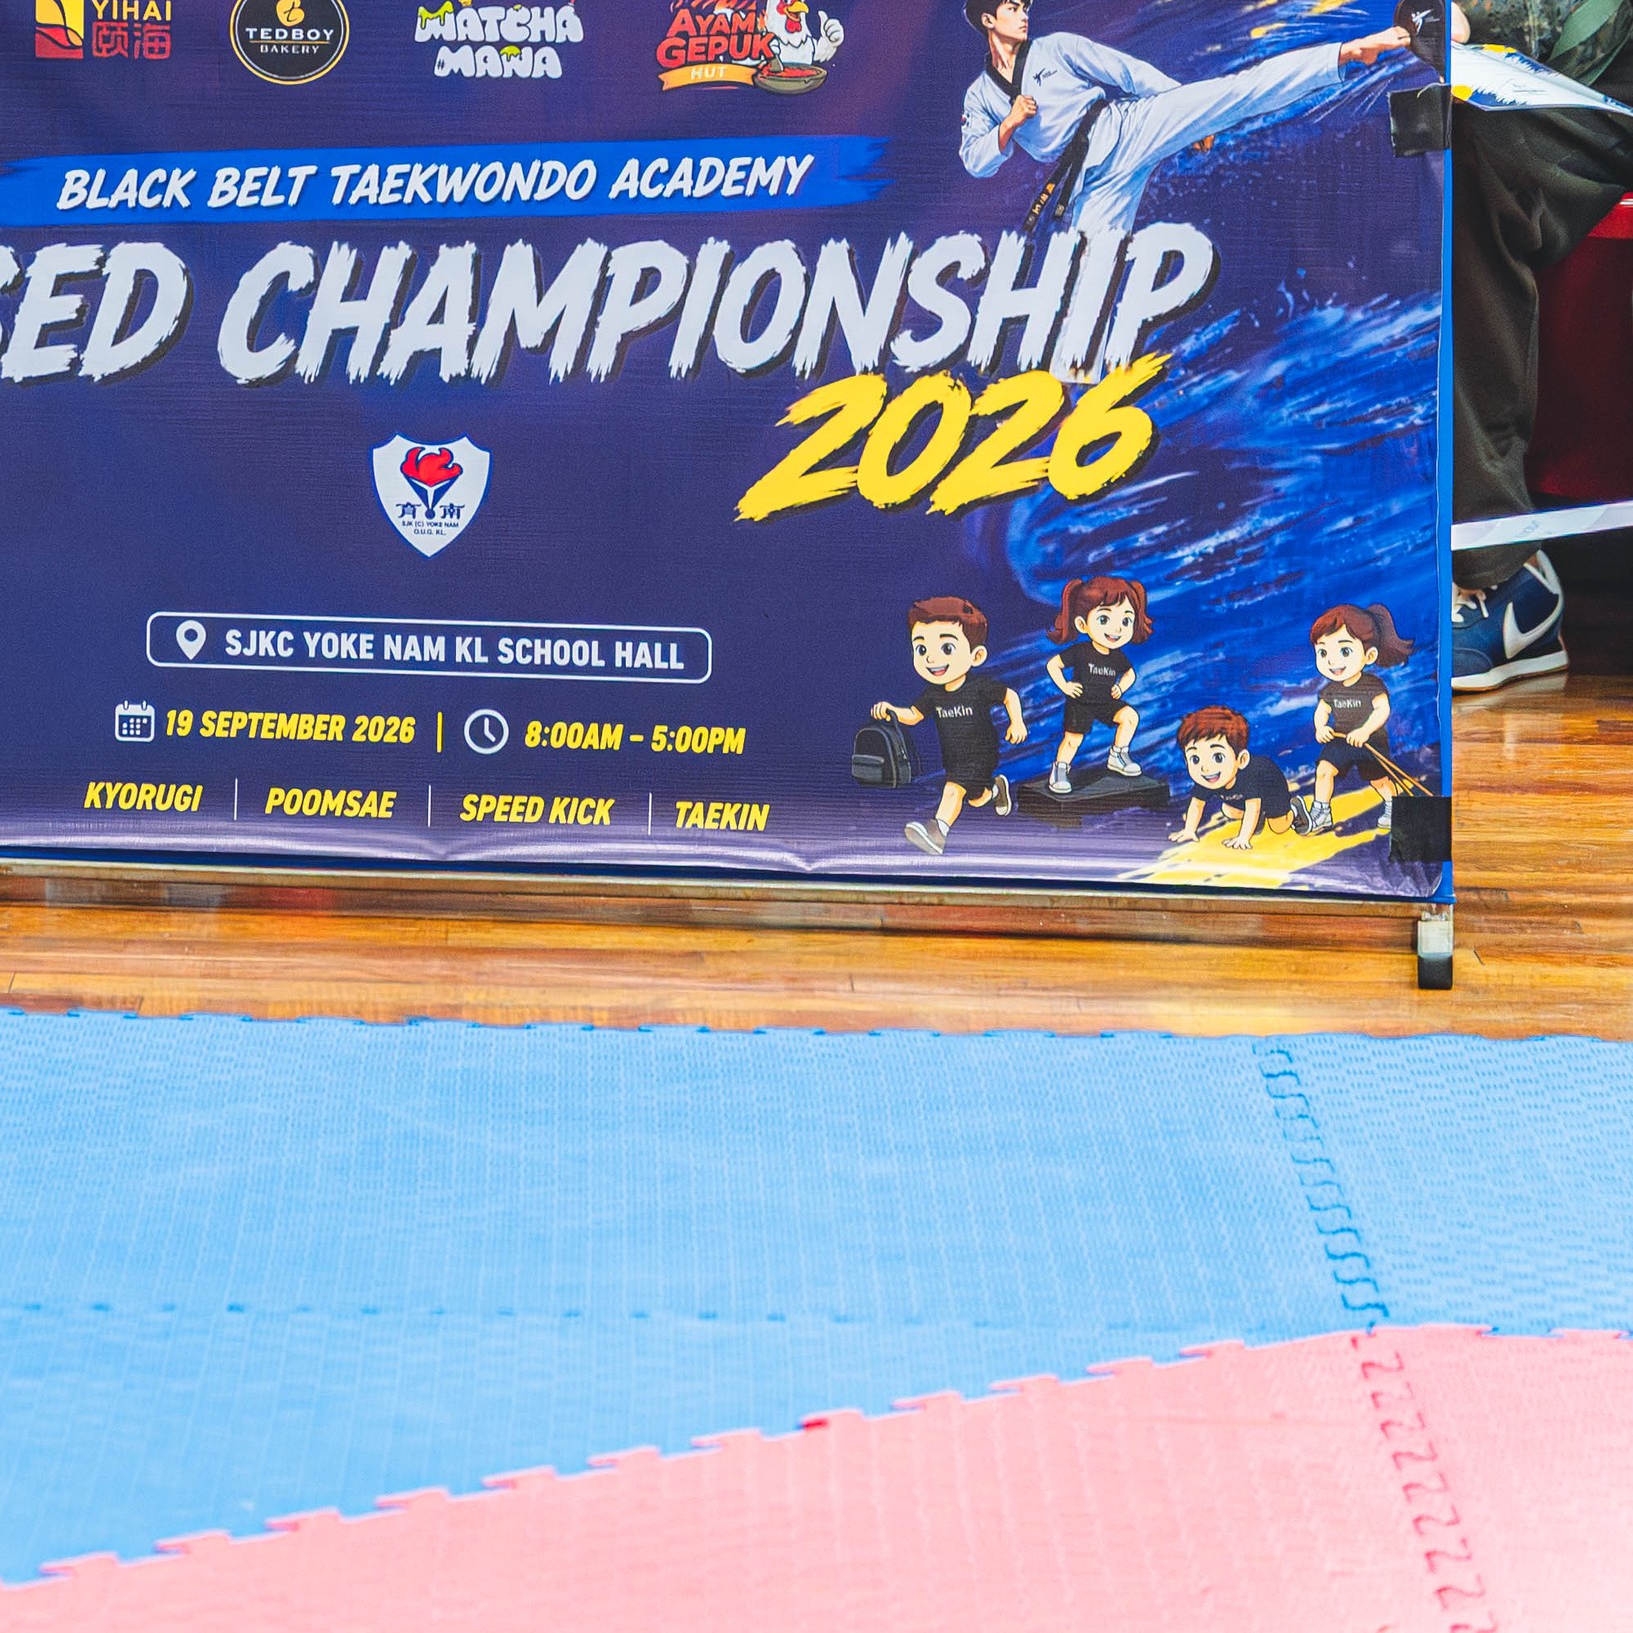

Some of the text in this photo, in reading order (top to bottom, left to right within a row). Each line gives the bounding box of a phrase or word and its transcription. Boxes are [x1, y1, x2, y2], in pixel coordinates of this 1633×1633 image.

[91, 0, 172, 21] YIHAI
[414, 1, 584, 43] MATCHA
[666, 8, 757, 37] AYAM
[245, 27, 335, 41] TEDBOY
[260, 44, 320, 55] BAKERY
[656, 32, 774, 68] GEPUK
[690, 66, 727, 80] HUT
[56, 155, 816, 211] BLACK BELT TAEKWONDO ACADEMY
[219, 222, 1215, 387] CHAMPIONSHIP
[734, 352, 1173, 521] 2026
[225, 629, 684, 669] SJKC YOKE NAM KL SCHOOL HALL
[165, 709, 416, 744] 19 SEPTEMBER 2026
[935, 705, 973, 719] TaeKin
[524, 722, 623, 751] 8:00AM
[651, 726, 746, 755] 5:00PM
[83, 782, 204, 812] KYORUGI
[265, 787, 397, 819] POOMSAE
[460, 794, 616, 826] SPEED KICK
[674, 801, 770, 832] TAEKIN
